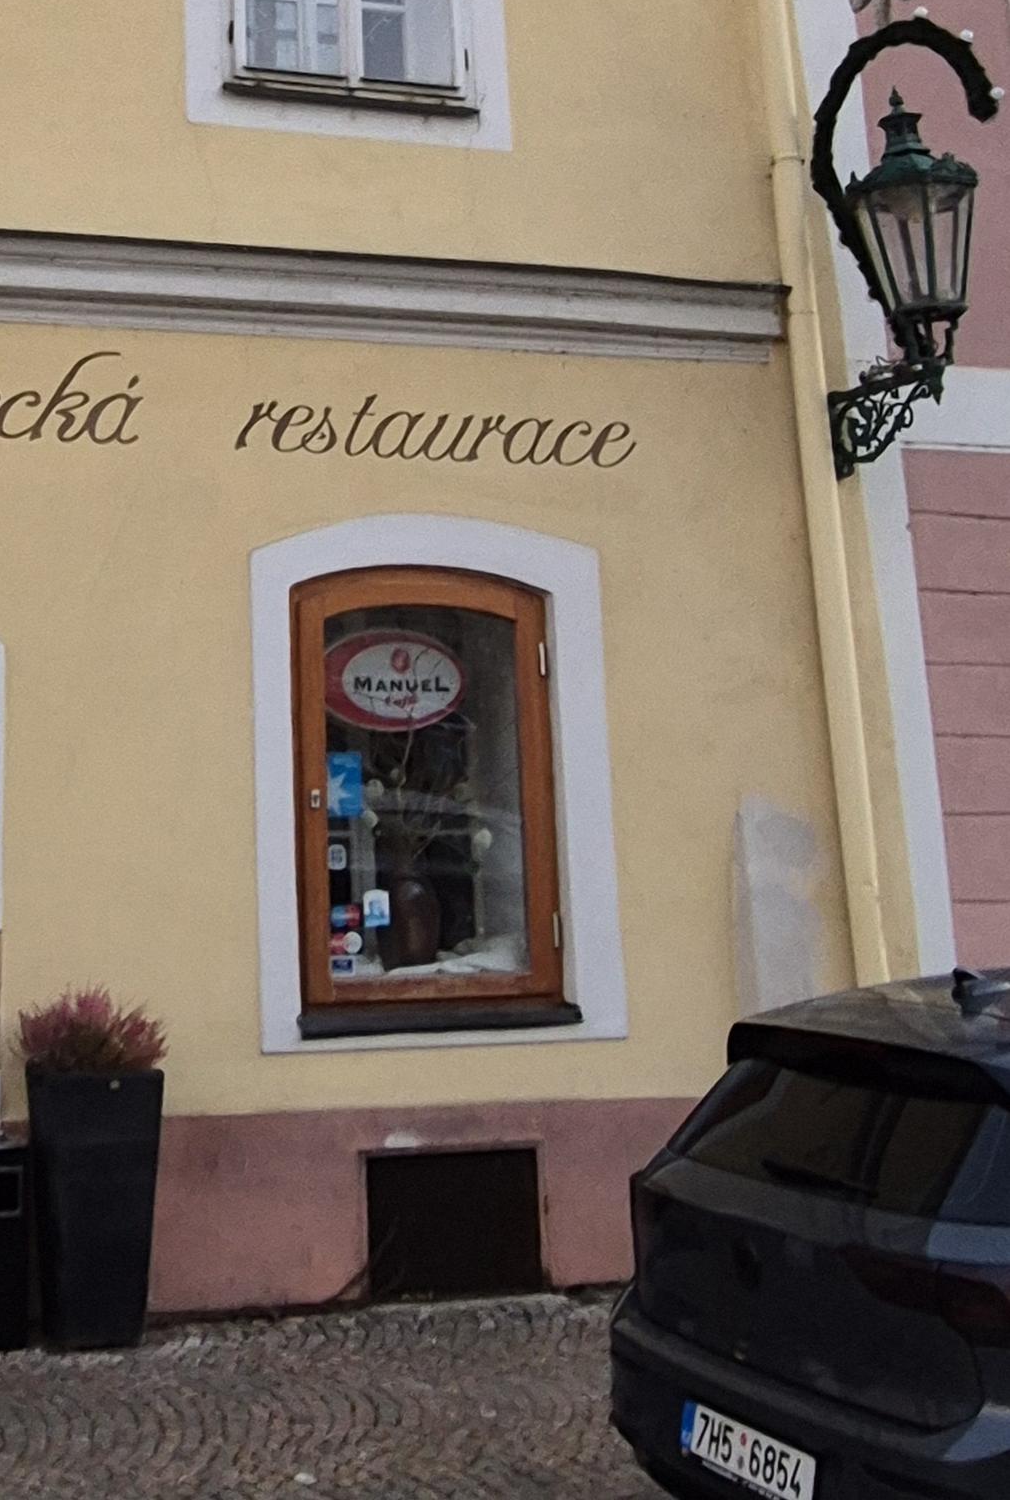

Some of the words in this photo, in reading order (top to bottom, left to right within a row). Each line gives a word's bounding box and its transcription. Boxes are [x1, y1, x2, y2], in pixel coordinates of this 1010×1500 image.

[234, 394, 636, 468] restaurace
[353, 676, 450, 693] MANUEL
[696, 1413, 734, 1463] 7H5
[749, 1439, 801, 1498] 6854
